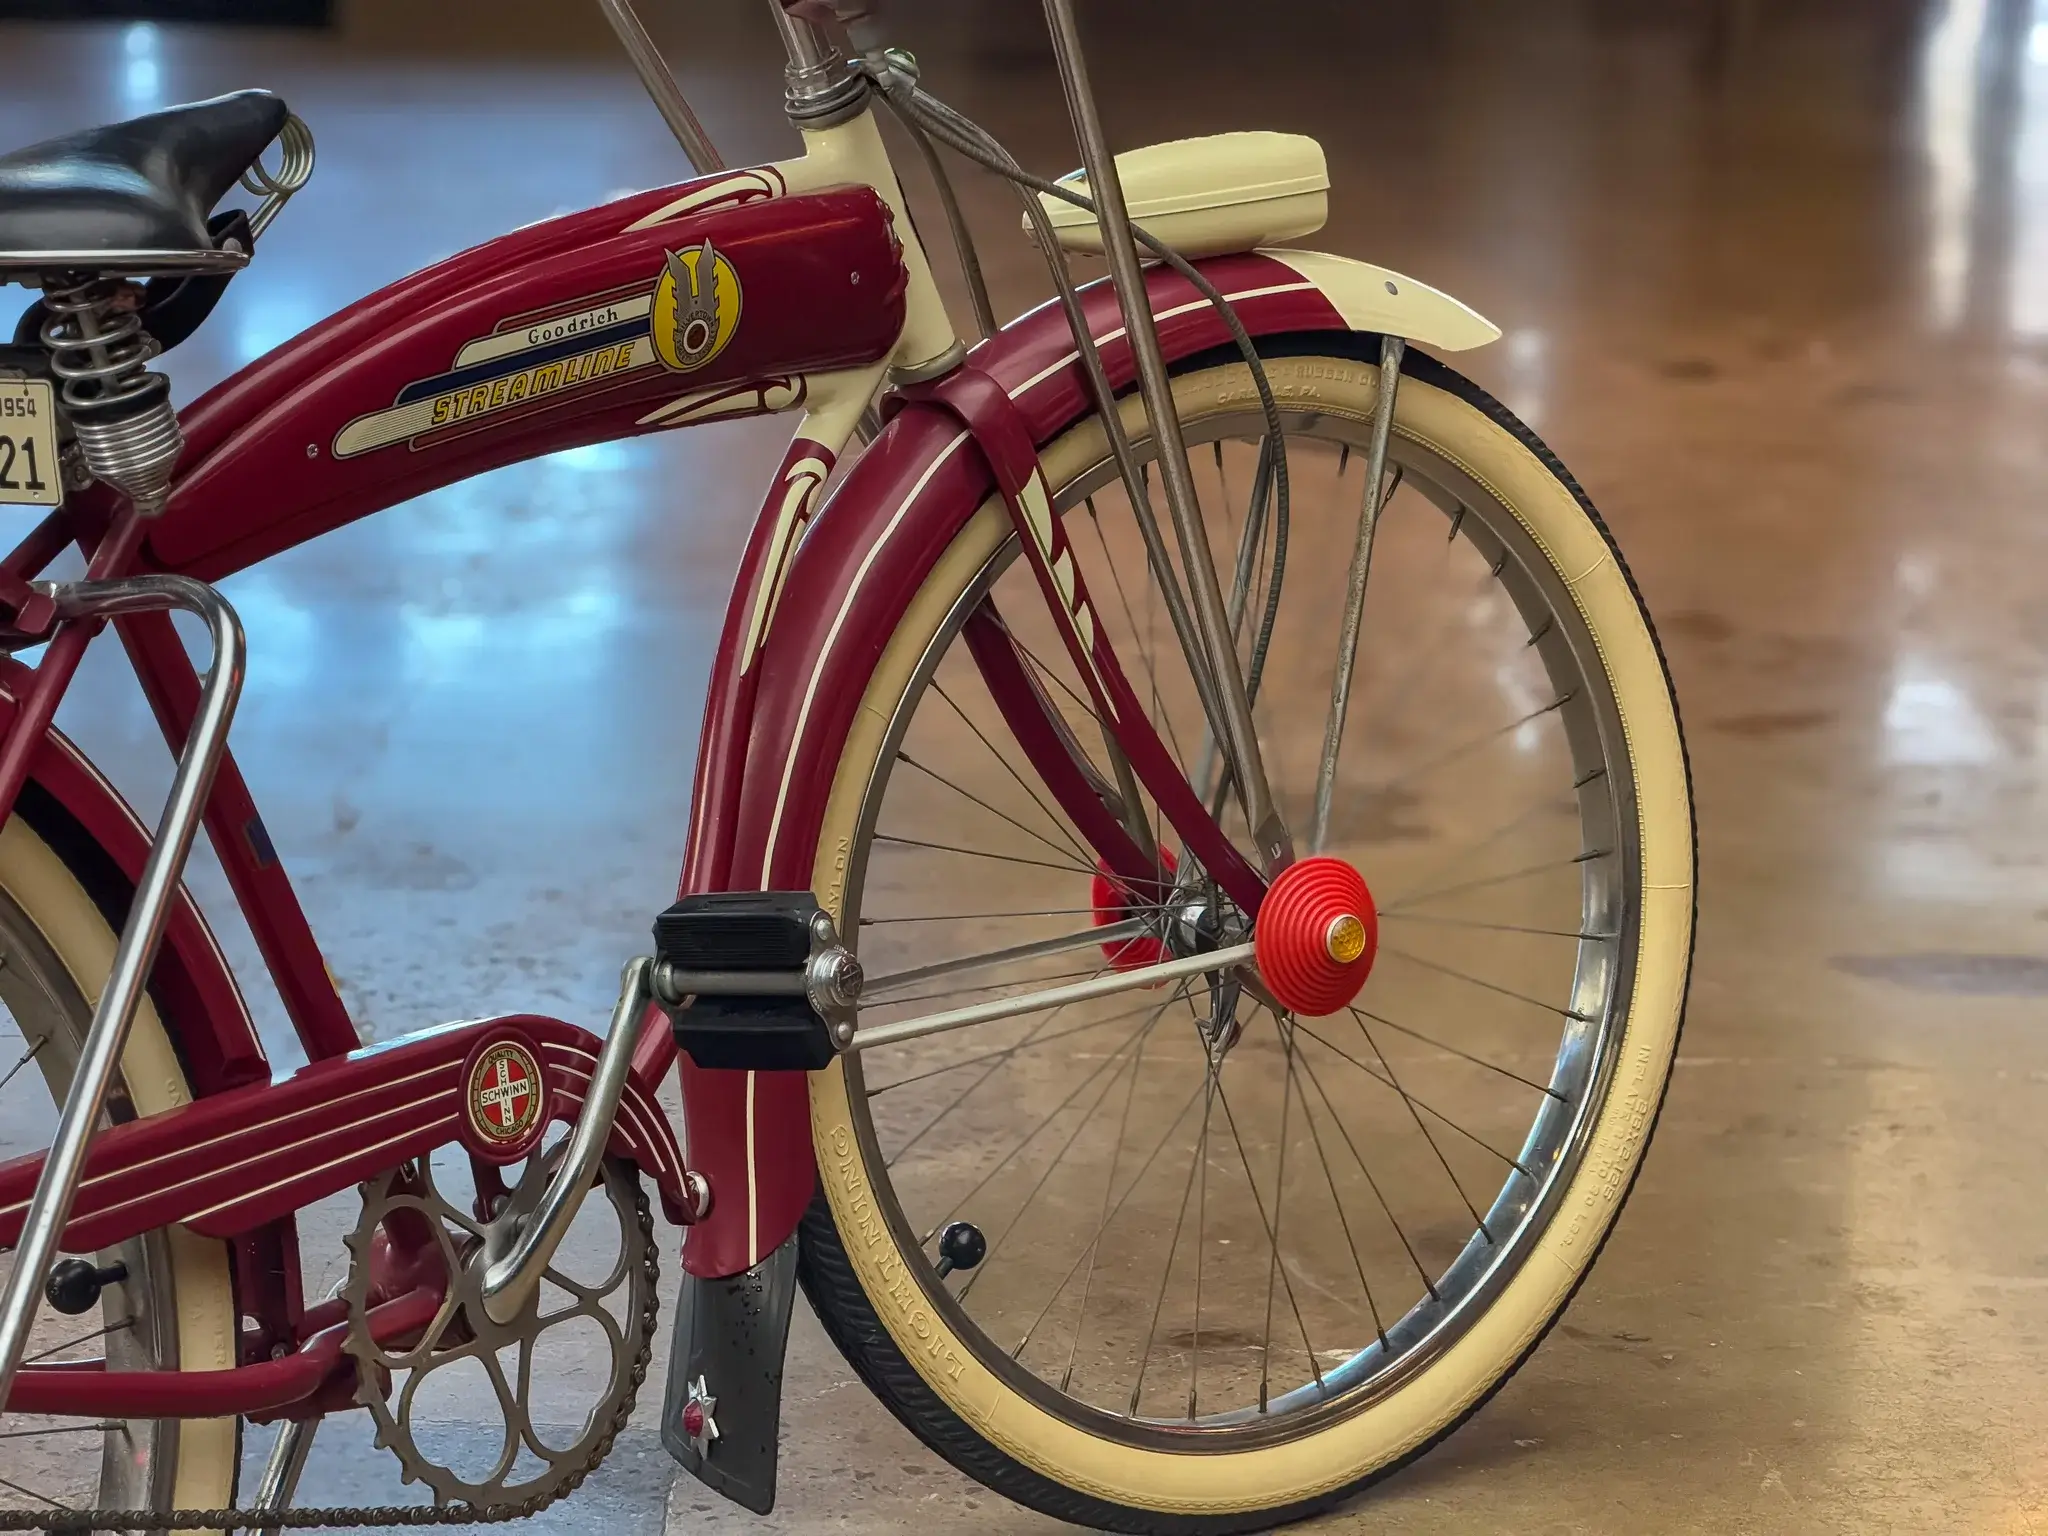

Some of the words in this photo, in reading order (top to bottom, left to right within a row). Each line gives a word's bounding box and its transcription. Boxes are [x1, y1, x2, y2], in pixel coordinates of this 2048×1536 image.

[527, 307, 619, 345] Goodrich
[431, 341, 637, 427] STREAMLINE
[827, 836, 849, 920] NYLON
[488, 1050, 514, 1064] QUALITY
[482, 1080, 528, 1104] SCHWINN
[495, 1120, 524, 1135] CHICAGO
[830, 1124, 967, 1384] LIGHTNING
